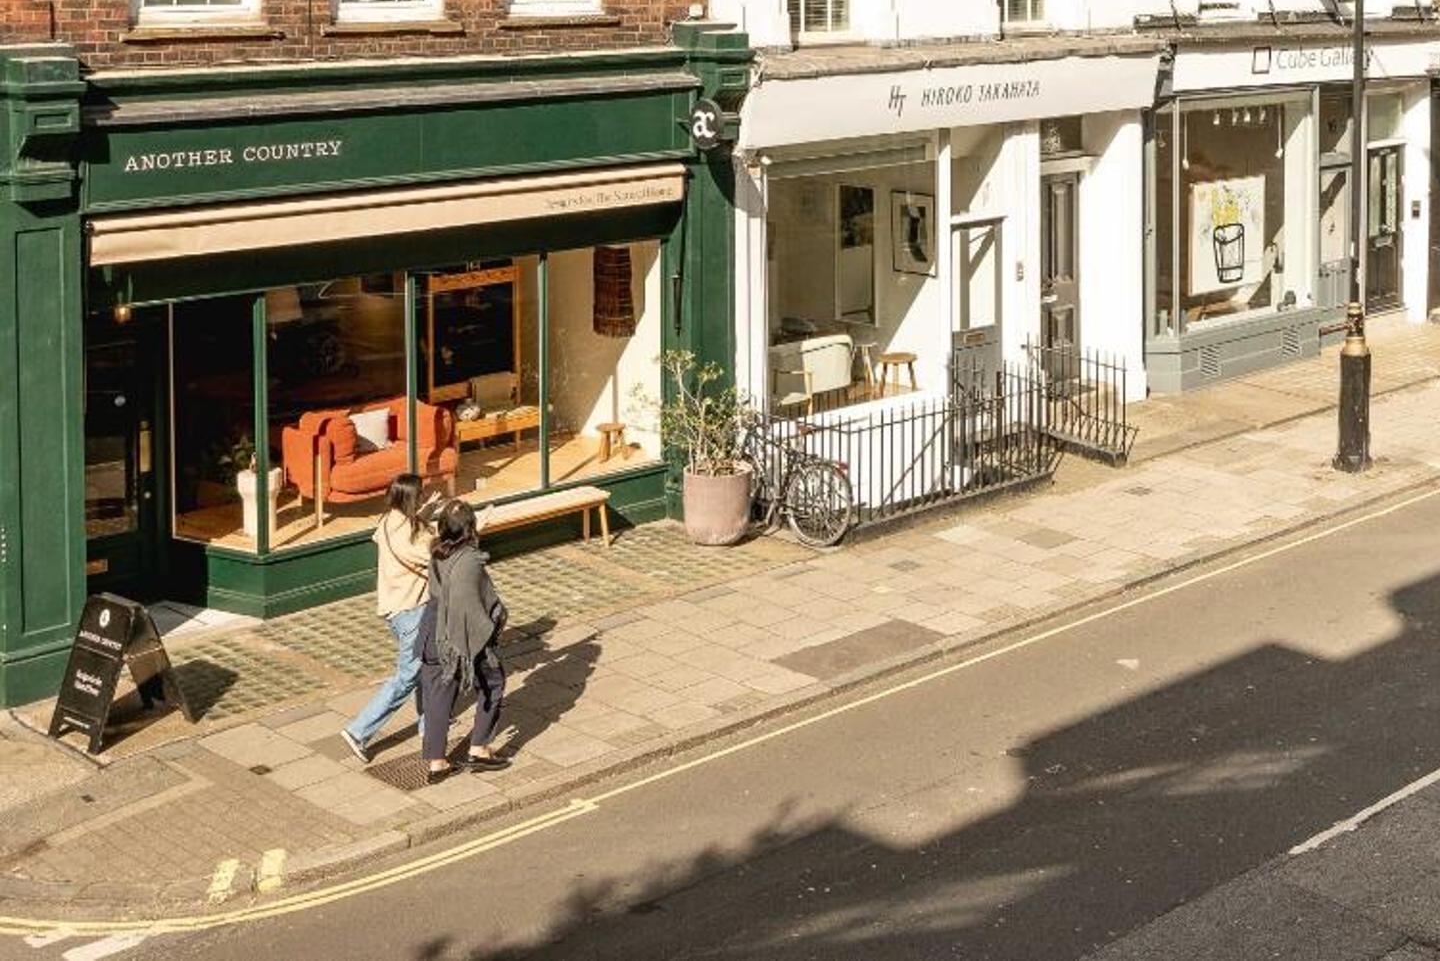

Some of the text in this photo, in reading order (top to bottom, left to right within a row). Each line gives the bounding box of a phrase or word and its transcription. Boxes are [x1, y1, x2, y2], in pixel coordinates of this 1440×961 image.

[1276, 43, 1374, 72] Cube Gally
[921, 84, 973, 107] HIROKO
[124, 140, 343, 172] ANOTHER COUNTRY
